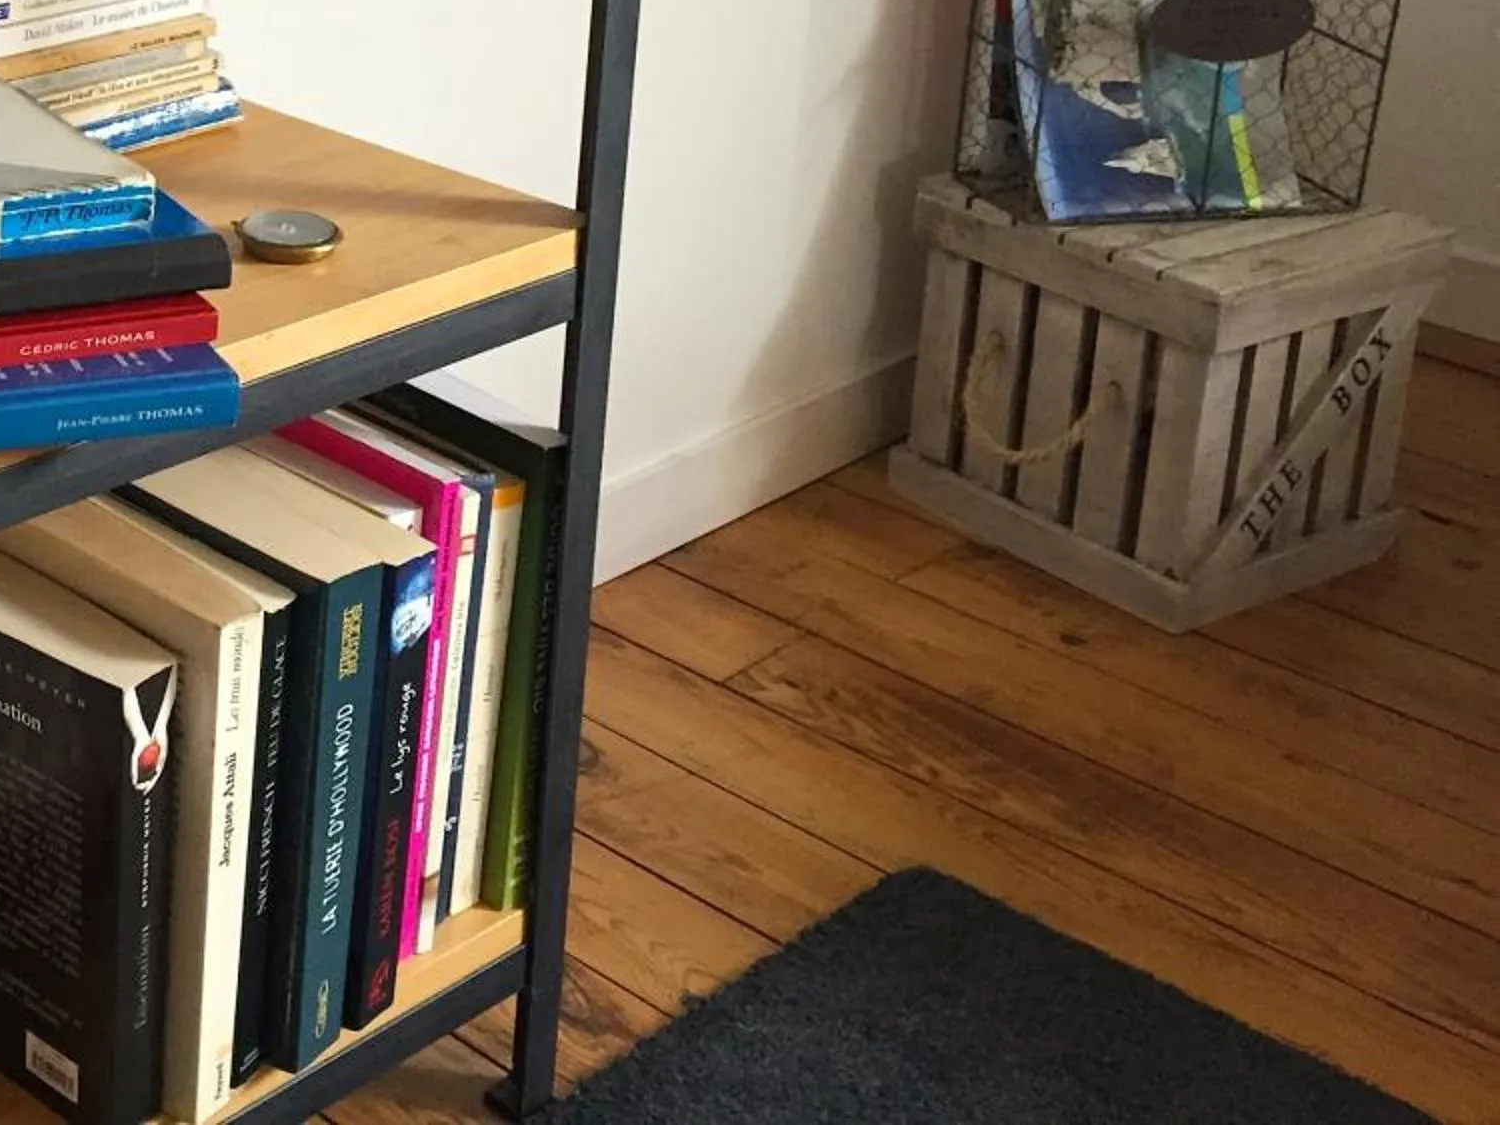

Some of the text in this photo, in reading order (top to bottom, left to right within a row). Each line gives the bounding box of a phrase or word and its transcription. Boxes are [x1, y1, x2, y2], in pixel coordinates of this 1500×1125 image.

[82, 329, 156, 349] THOMAS
[137, 403, 205, 424] THOMAS
[1240, 327, 1393, 542] THE BOX
[26, 674, 86, 709] MEYER
[390, 682, 417, 796] Le lys rouge
[223, 752, 238, 799] Attali
[219, 801, 235, 868] Jacques
[323, 703, 355, 936] LA TUERIE D'HOLLYWOOD
